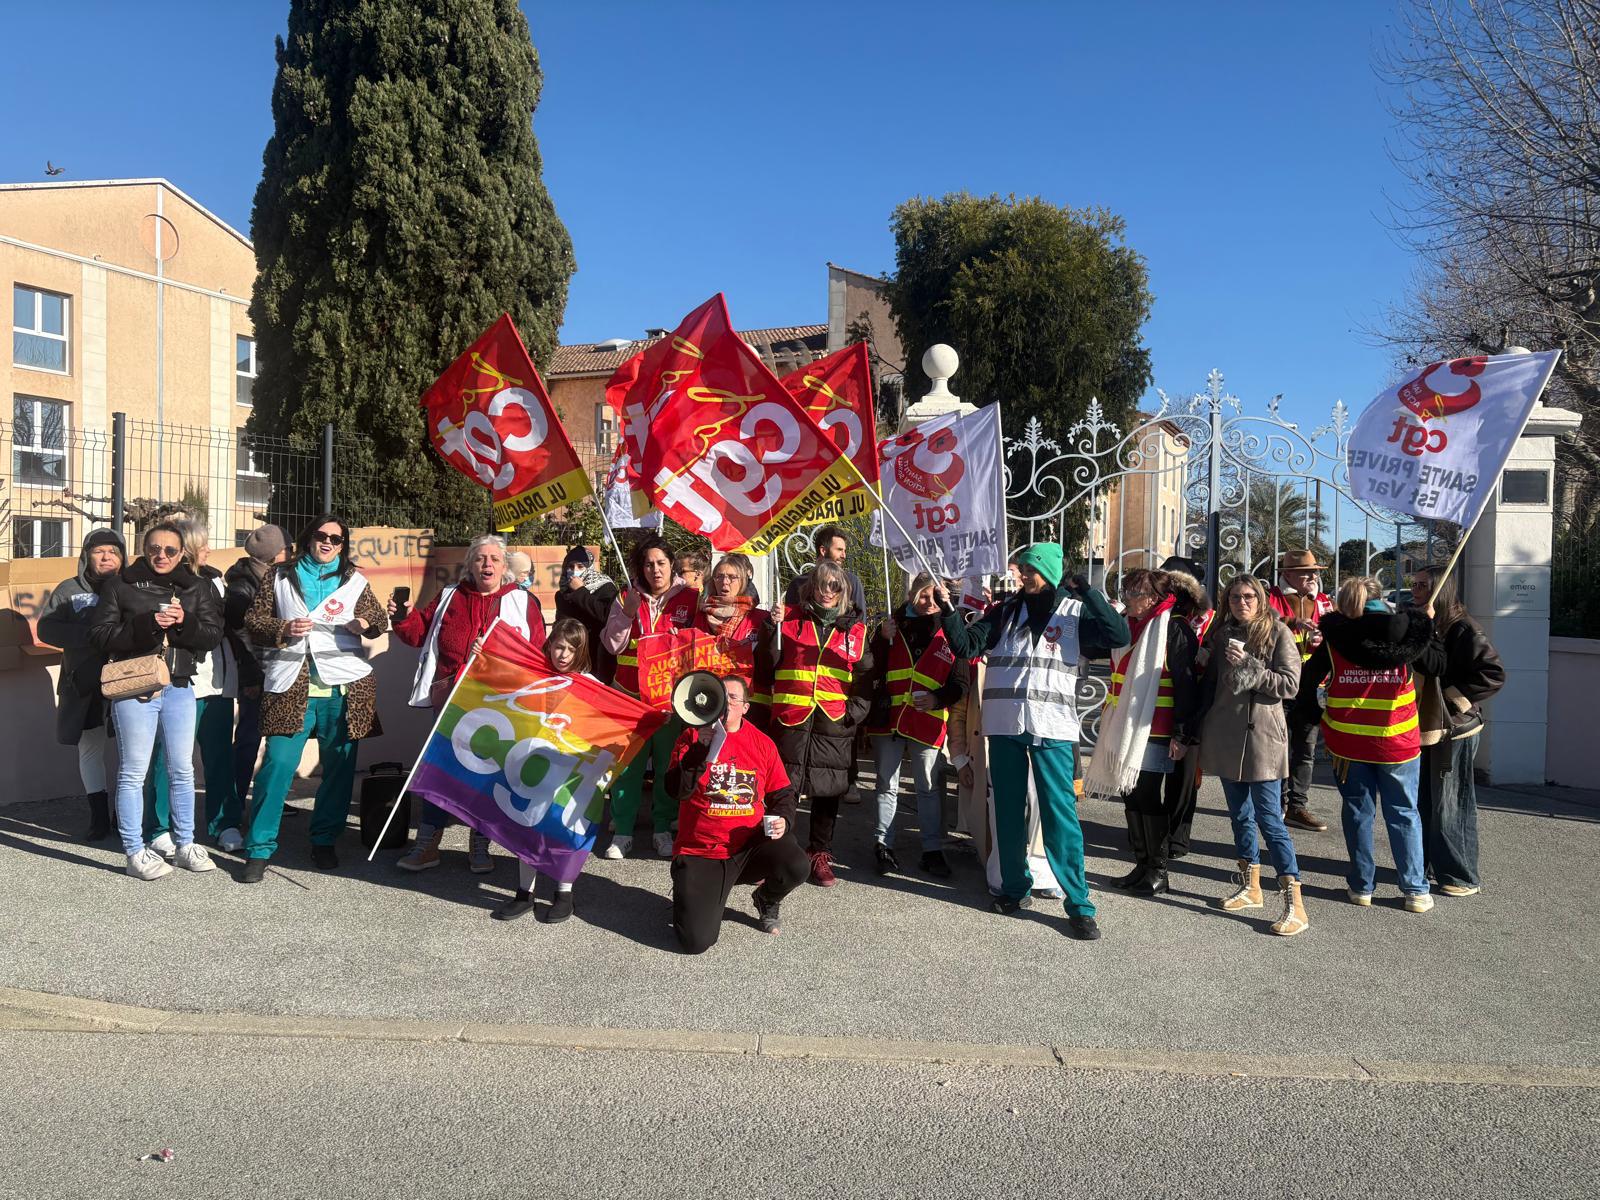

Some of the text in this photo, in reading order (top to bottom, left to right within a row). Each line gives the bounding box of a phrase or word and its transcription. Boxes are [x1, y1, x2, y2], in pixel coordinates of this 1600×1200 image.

[647, 670, 671, 688] LES
[1338, 675, 1404, 684] DRAGUIGNAN
[451, 707, 615, 836] cgt
[710, 763, 729, 775] cgt
